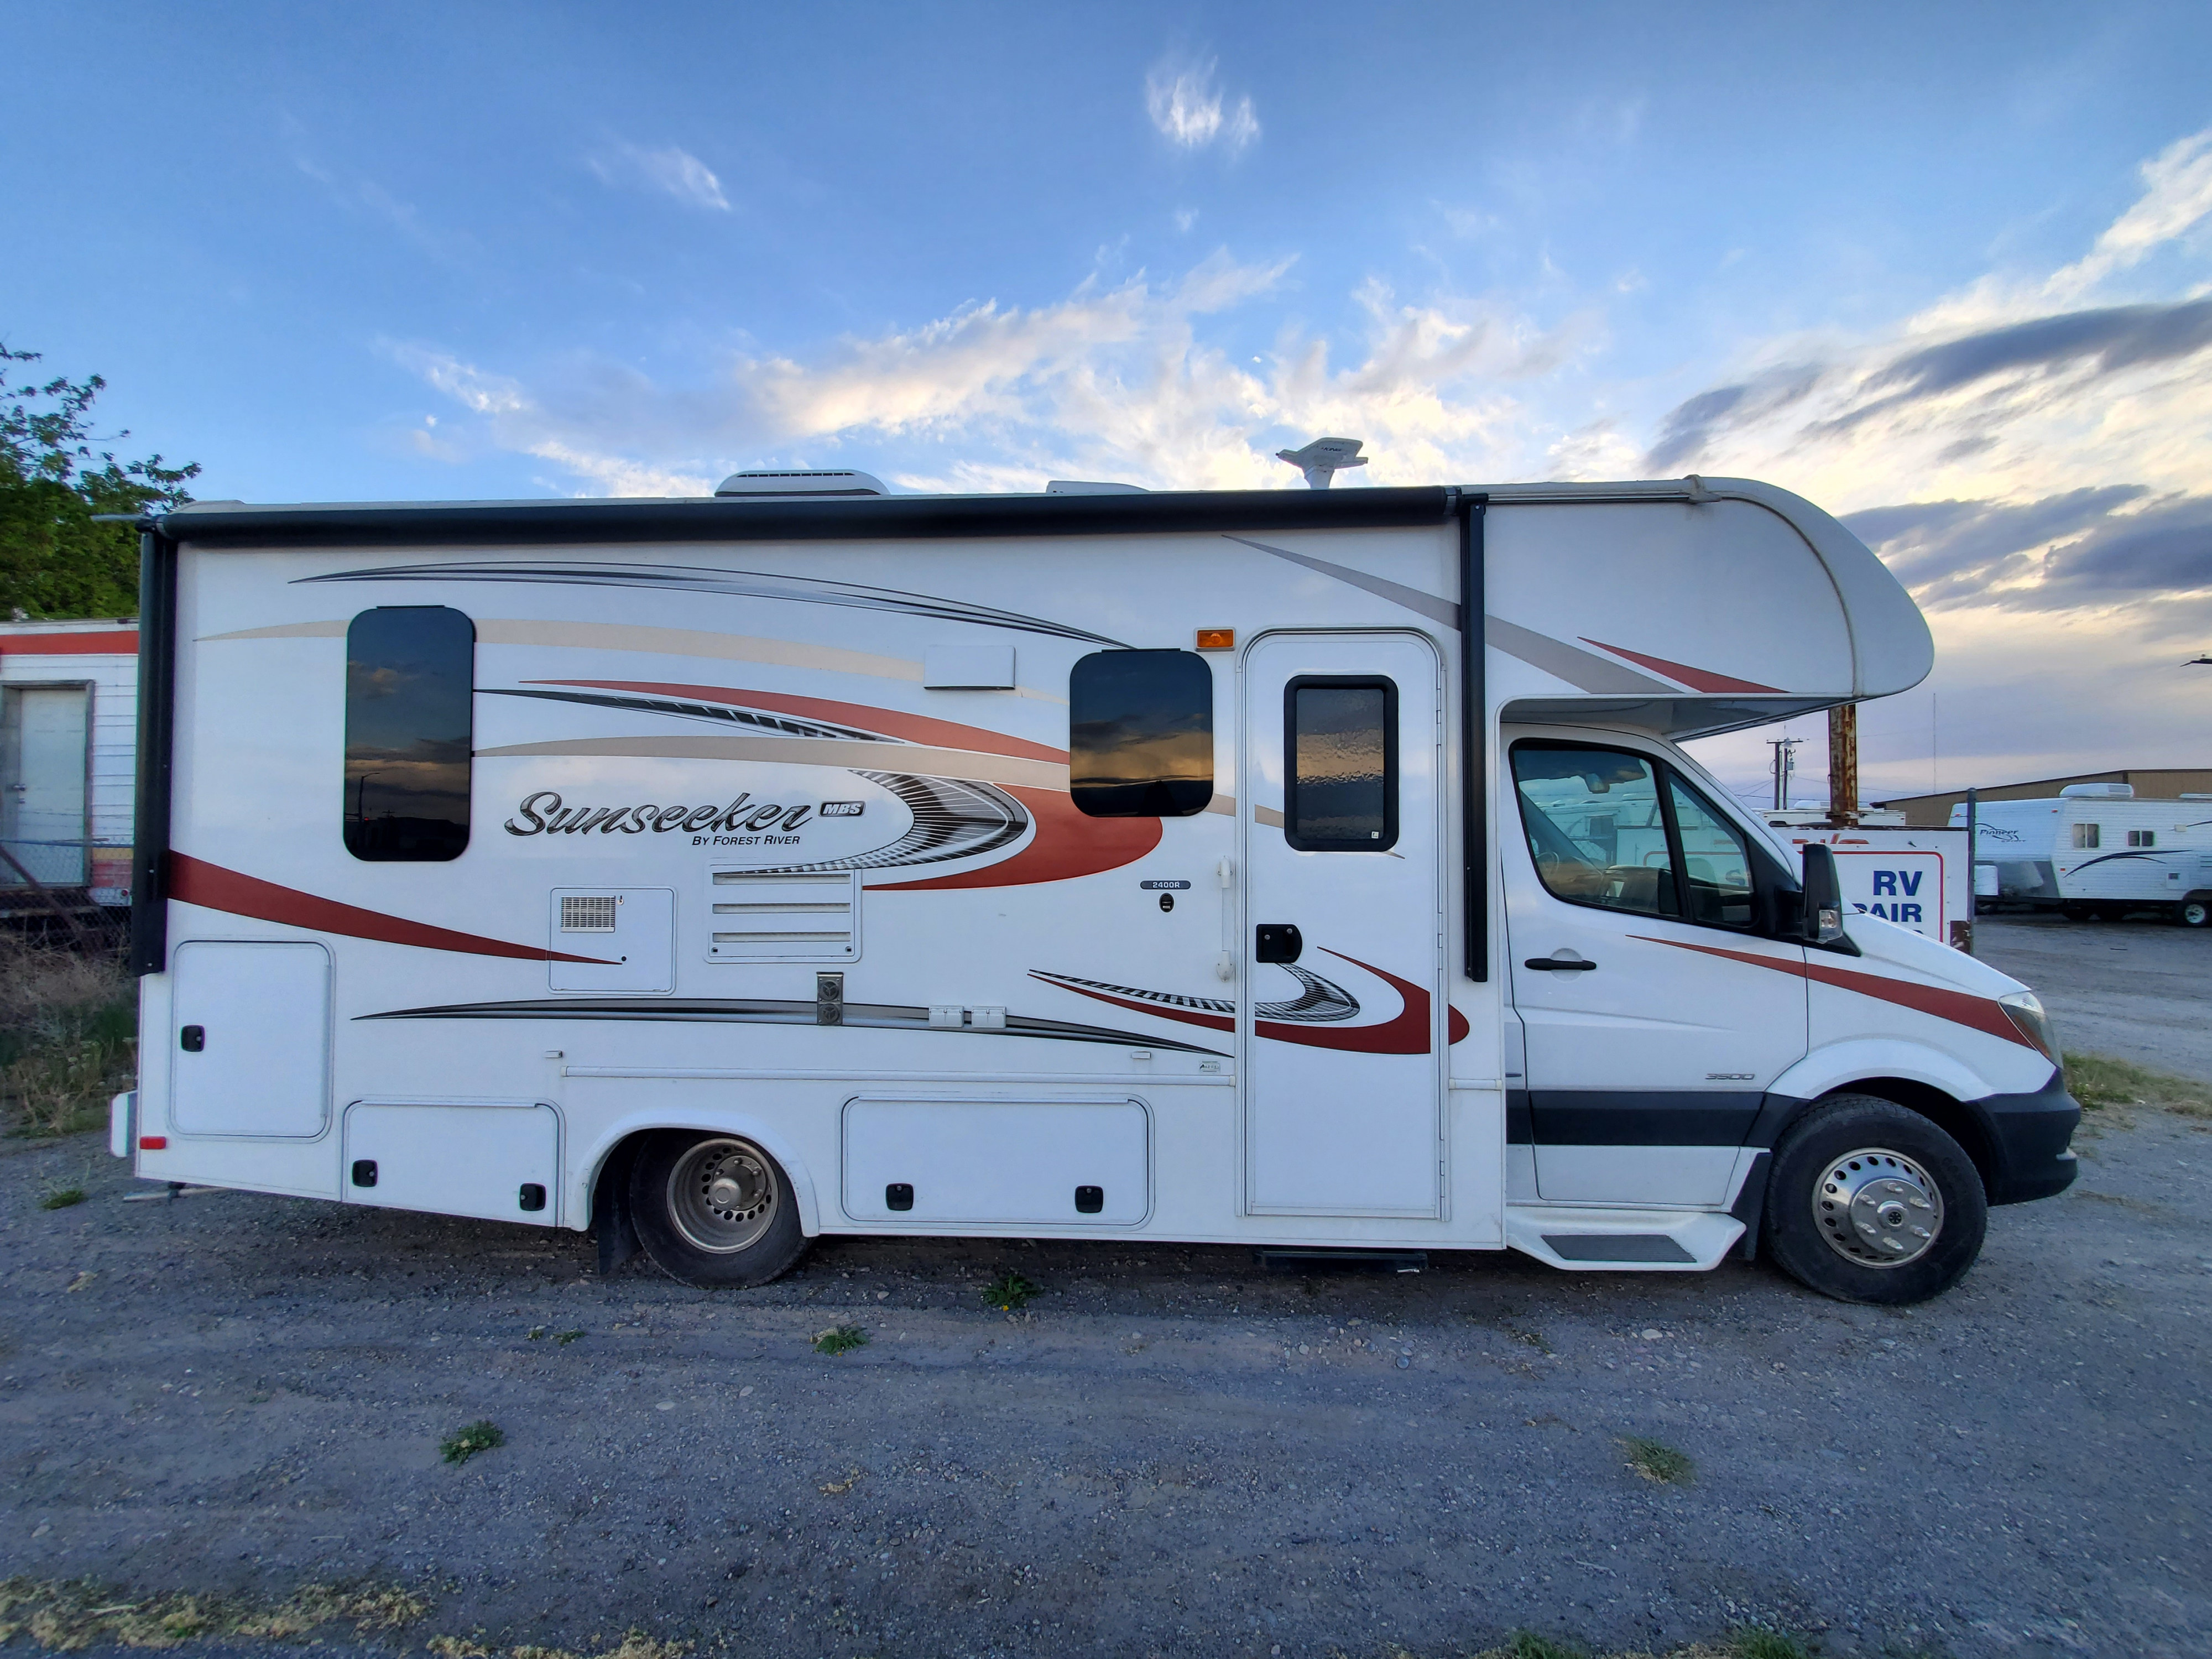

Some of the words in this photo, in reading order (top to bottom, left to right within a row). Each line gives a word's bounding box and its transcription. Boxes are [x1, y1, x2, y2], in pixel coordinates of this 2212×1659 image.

[504, 791, 813, 836] Sunseeker
[822, 804, 861, 814] MBS
[1873, 870, 1922, 896] RV
